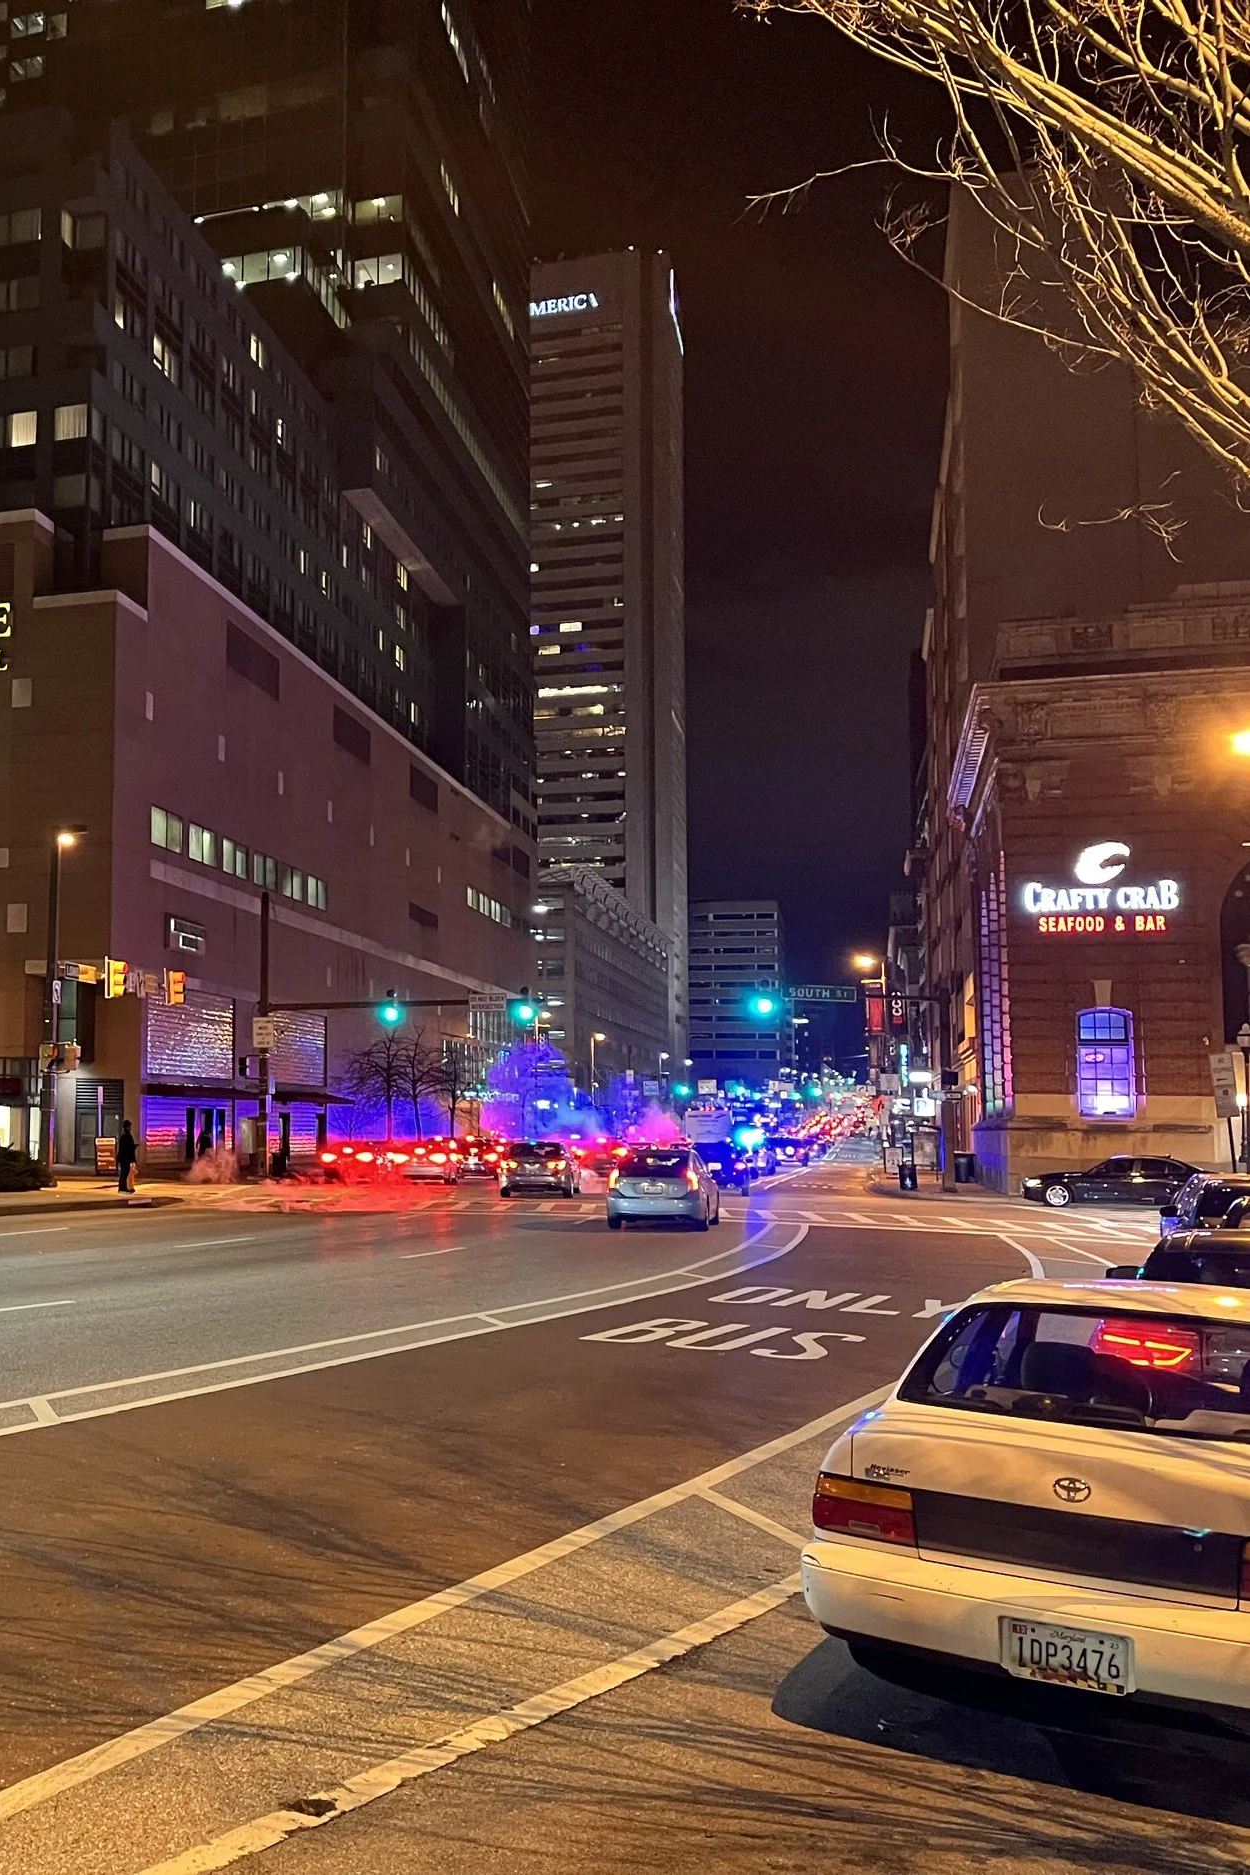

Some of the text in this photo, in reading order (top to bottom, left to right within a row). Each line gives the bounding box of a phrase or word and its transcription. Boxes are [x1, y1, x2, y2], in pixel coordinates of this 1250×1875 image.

[1023, 879, 1180, 913] CRAFTY CRAB
[1038, 915, 1166, 932] SEAFOOD & BAR
[789, 987, 830, 998] SOUTH
[707, 1286, 964, 1319] ONLY
[578, 1317, 867, 1360] BUS
[1050, 1630, 1087, 1644] Maryland
[1018, 1636, 1121, 1682] 1DP3476
